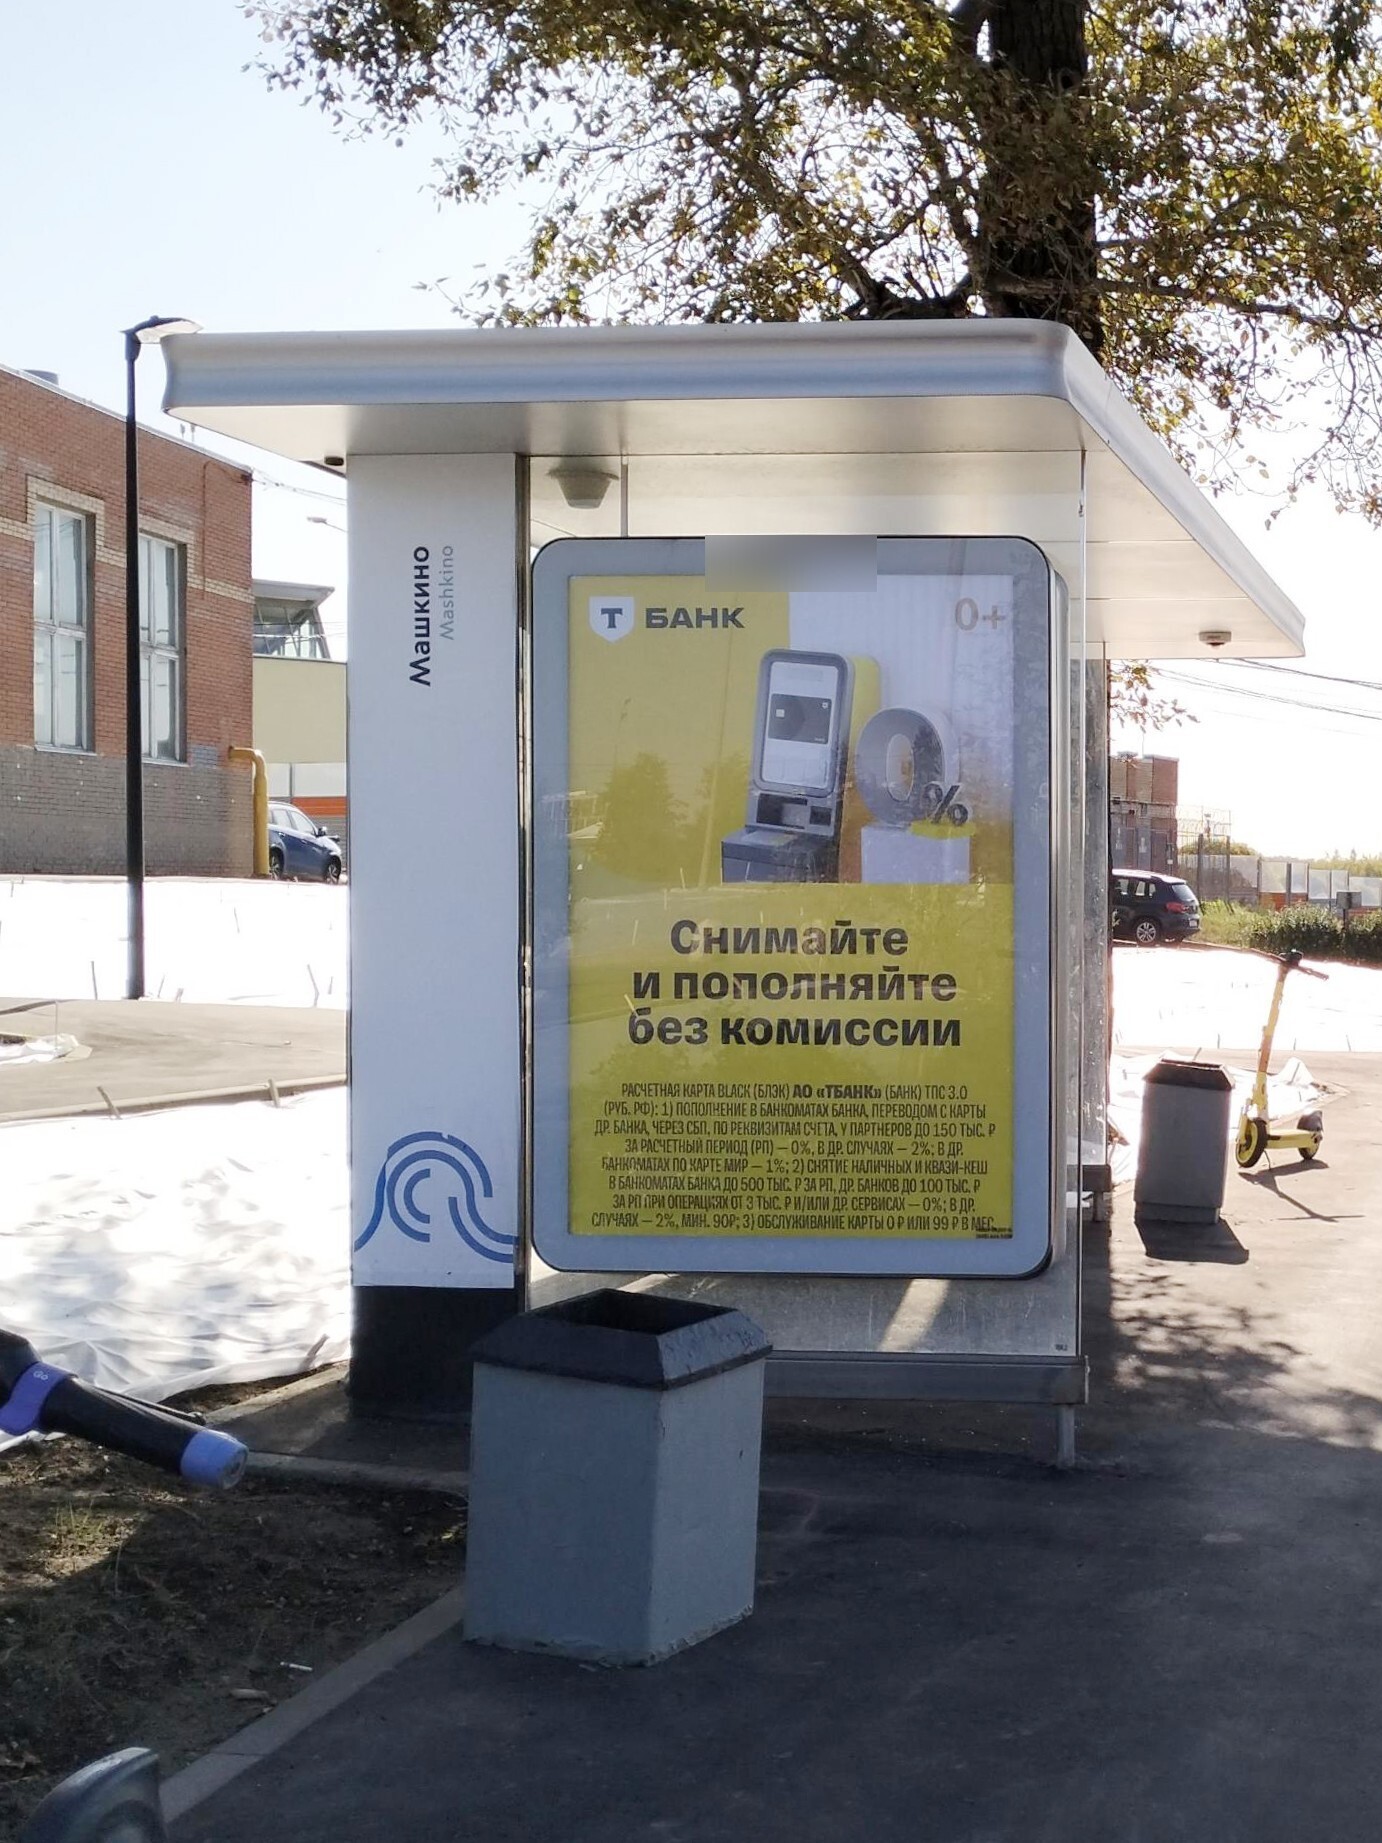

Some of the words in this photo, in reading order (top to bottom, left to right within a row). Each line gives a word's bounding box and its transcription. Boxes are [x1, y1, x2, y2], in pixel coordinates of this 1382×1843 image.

[438, 545, 454, 641] Mashkino
[409, 546, 431, 687] Машкино
[645, 607, 745, 629] БАНК
[954, 598, 1007, 631] 0+
[670, 919, 909, 957] Снимайте
[633, 972, 660, 1000] и
[674, 966, 957, 1002] пополняйте
[628, 1007, 708, 1046] без
[720, 1017, 960, 1047] комиссии
[622, 1083, 680, 1098] РАСЧЕТНАЯ
[683, 1083, 716, 1098] КАРТА
[718, 1083, 751, 1098] BLACK
[753, 1084, 790, 1101] (БЛЭК)
[816, 1084, 882, 1099] «ТБАНК»
[884, 1085, 922, 1102] (БАНК)
[604, 1102, 631, 1119] (РУБ.
[634, 1102, 658, 1119] РФ):
[676, 1102, 748, 1117] ПОПОЛНЕНИЕ
[760, 1103, 828, 1118] БАНКОМАТАХ
[831, 1103, 869, 1120] БАНКА,
[871, 1103, 938, 1120] ПЕРЕВОДОМ
[950, 1104, 986, 1119] КАРТЫ
[614, 1120, 650, 1137] БАНКА,
[652, 1121, 684, 1136] ЧЕРЕЗ
[686, 1121, 710, 1138] СБП,
[730, 1121, 800, 1136] РЕКВИЗИТАМ
[850, 1122, 912, 1137] ПАРТНЕРОВ
[960, 1123, 986, 1138] ТЫС.
[641, 1139, 704, 1154] РАСЧЕТНЫЙ
[706, 1140, 748, 1157] ПЕРИОД
[750, 1140, 774, 1157] (РП)
[846, 1141, 894, 1156] СЛУЧАЯХ
[602, 1158, 670, 1173] БАНКОМАТАХ
[690, 1158, 722, 1173] КАРТЕ
[807, 1159, 848, 1174] СНЯТИЕ
[851, 1159, 912, 1174] НАЛИЧНЫХ
[924, 1160, 988, 1175] КВАЗИ-КЕШ
[618, 1176, 686, 1191] БАНКОМАТАХ
[688, 1177, 722, 1192] БАНКА
[767, 1177, 792, 1192] ТЫС.
[857, 1178, 900, 1193] БАНКОВ
[945, 1179, 971, 1194] ТЫС.
[668, 1195, 728, 1212] ОПЕРАЦИЯХ
[756, 1196, 782, 1211] ТЫС.
[794, 1196, 830, 1211] И/ИЛИ
[851, 1197, 905, 1212] СЕРВИСАХ
[591, 1213, 640, 1228] СЛУЧАЯХ
[680, 1214, 710, 1229] МИН.
[757, 1214, 845, 1229] ОБСЛУЖИВАНИЕ
[848, 1215, 884, 1230] КАРТЫ
[33, 1370, 49, 1381] Go
